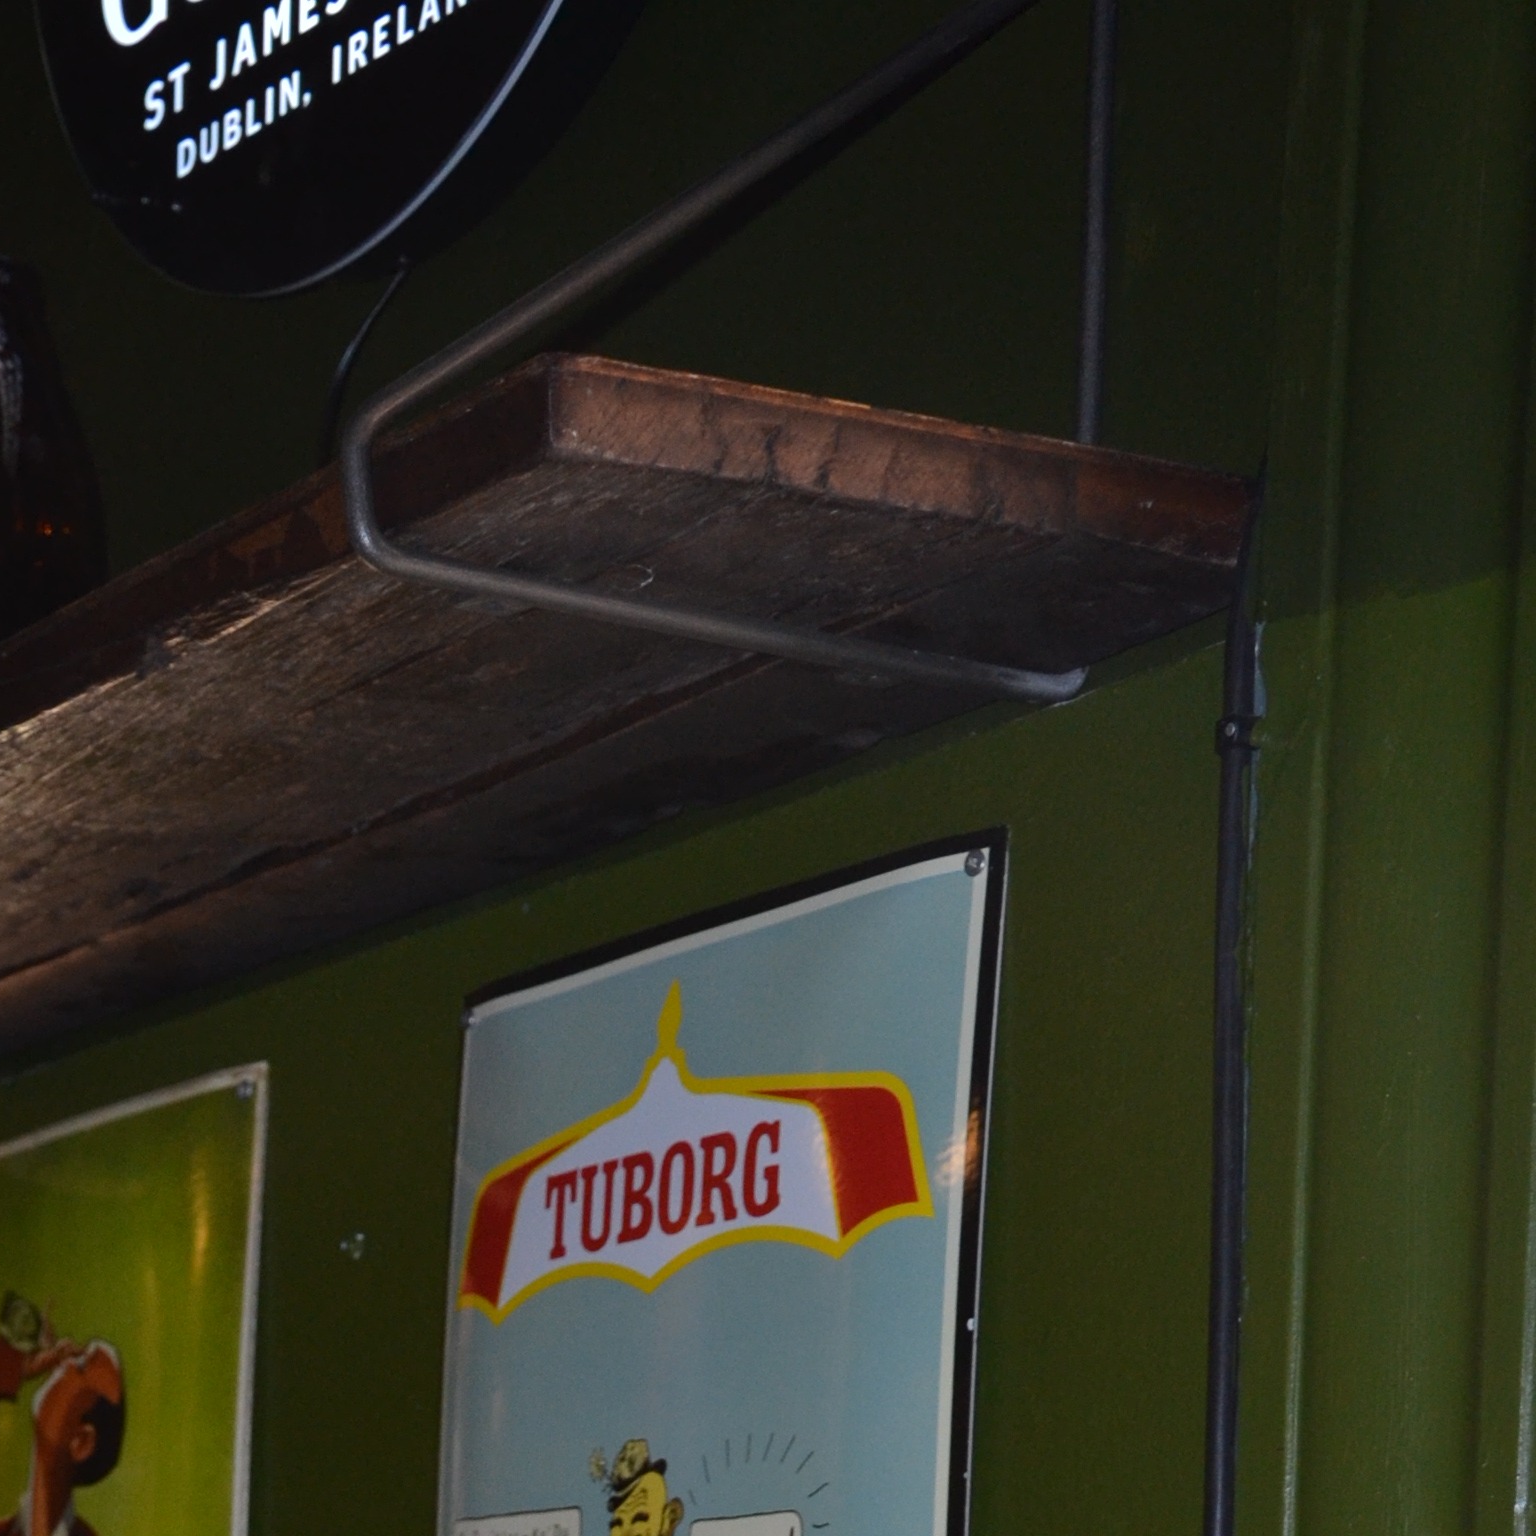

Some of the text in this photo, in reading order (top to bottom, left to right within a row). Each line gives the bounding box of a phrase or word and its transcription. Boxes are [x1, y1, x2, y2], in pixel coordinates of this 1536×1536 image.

[143, 62, 192, 132] ST
[176, 70, 312, 180] DUBLIN,
[544, 1119, 781, 1261] TUBORG
